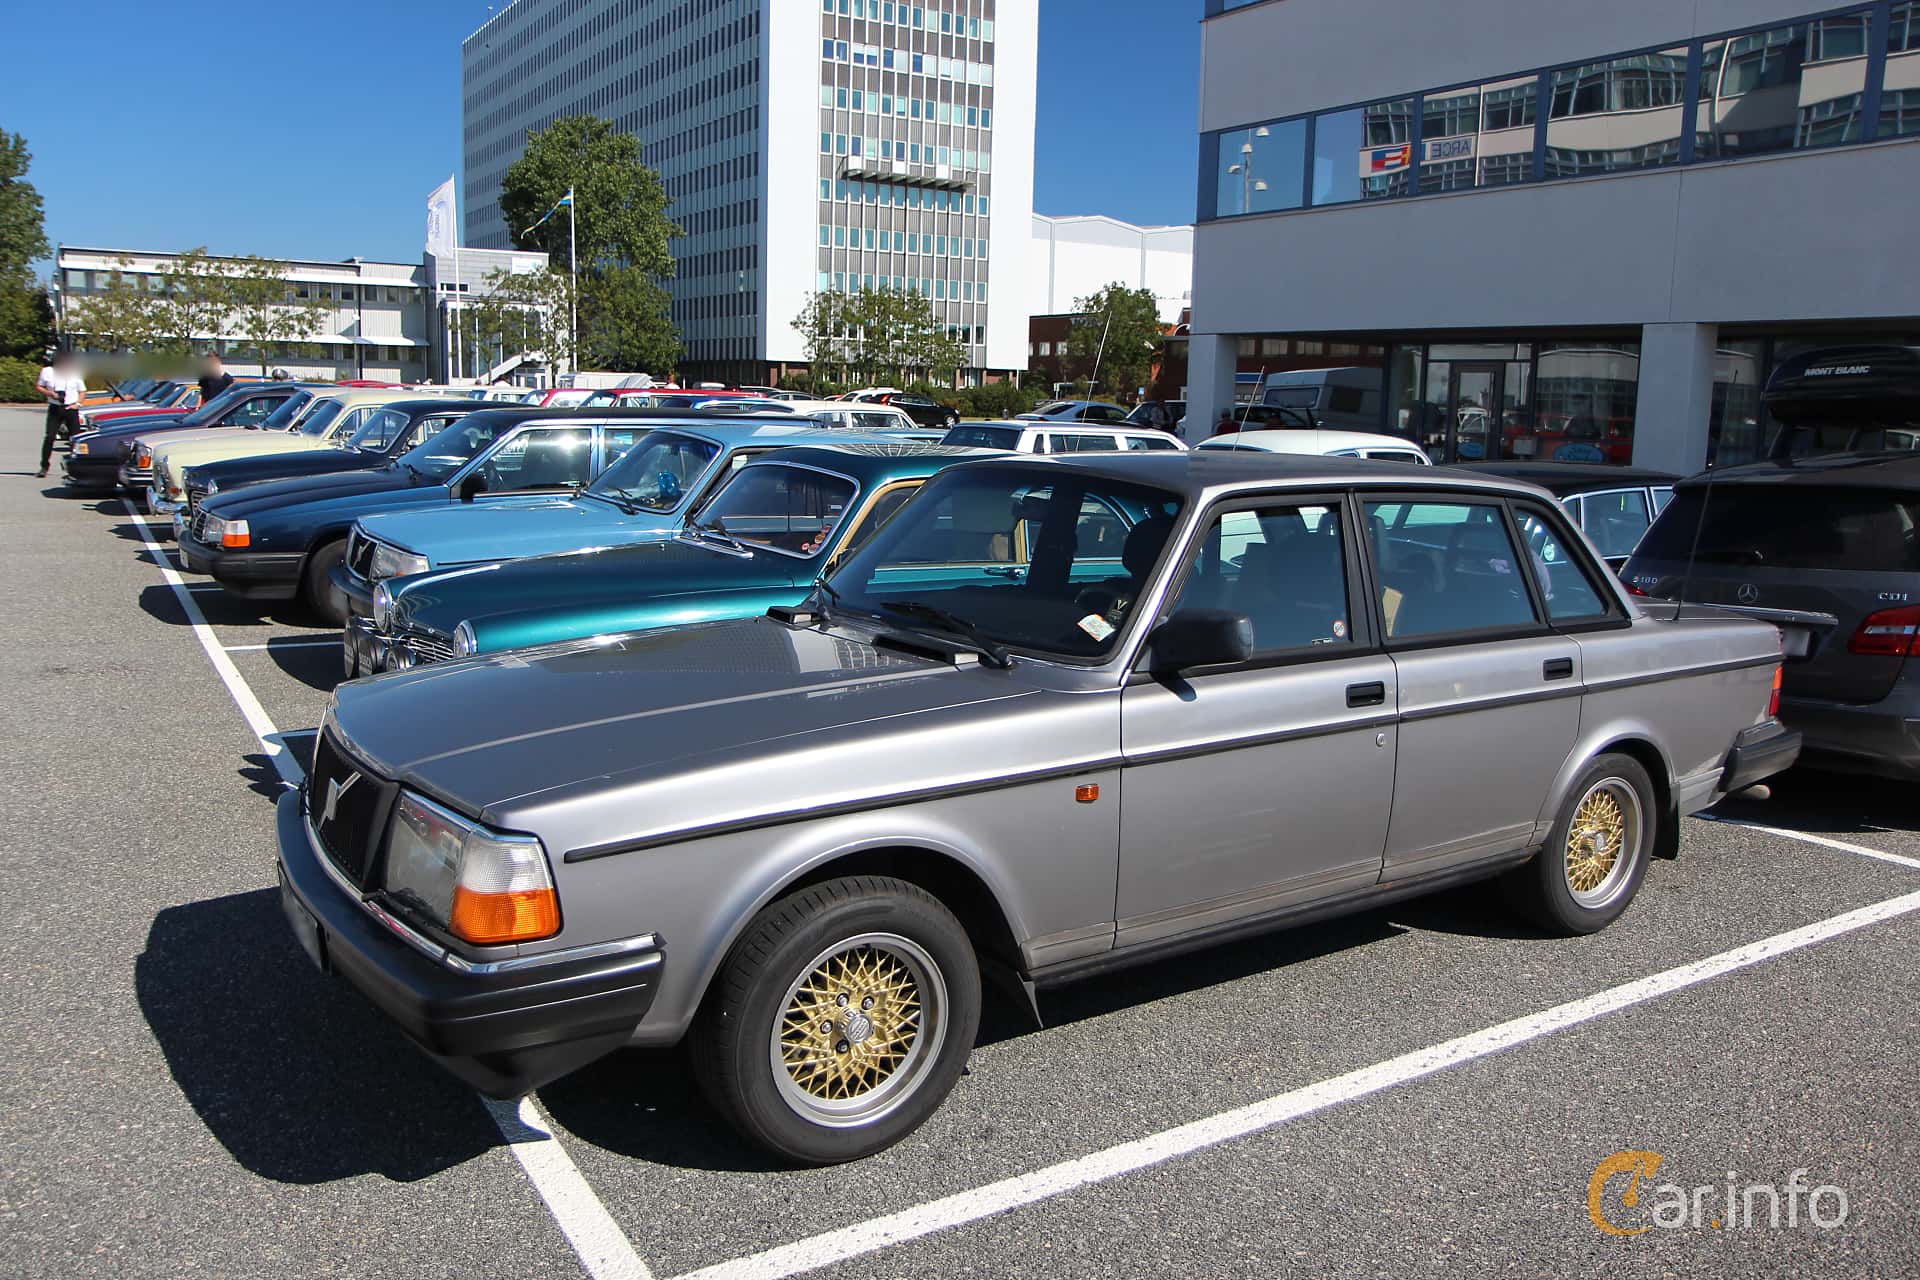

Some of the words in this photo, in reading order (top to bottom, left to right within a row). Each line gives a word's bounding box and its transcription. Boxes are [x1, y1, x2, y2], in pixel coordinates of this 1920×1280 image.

[1804, 367, 1834, 377] MONT
[1835, 365, 1870, 375] BLANC
[1878, 592, 1907, 601] CDI
